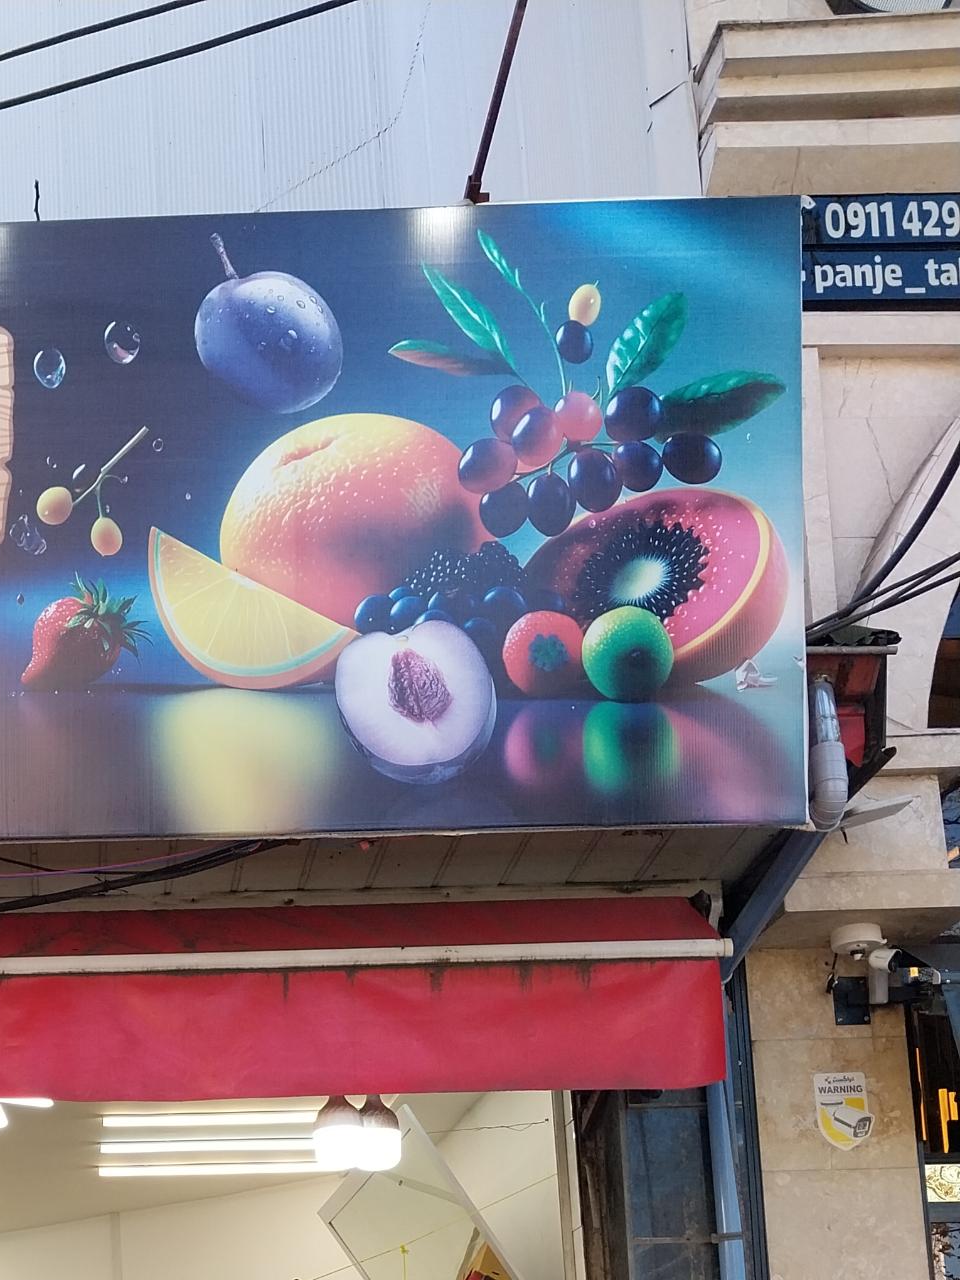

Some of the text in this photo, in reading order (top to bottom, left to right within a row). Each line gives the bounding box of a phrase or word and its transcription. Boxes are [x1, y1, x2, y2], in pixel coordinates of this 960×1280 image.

[825, 201, 960, 238] 0911 429
[814, 255, 960, 294] panje_ta
[818, 1085, 863, 1094] WARNING
